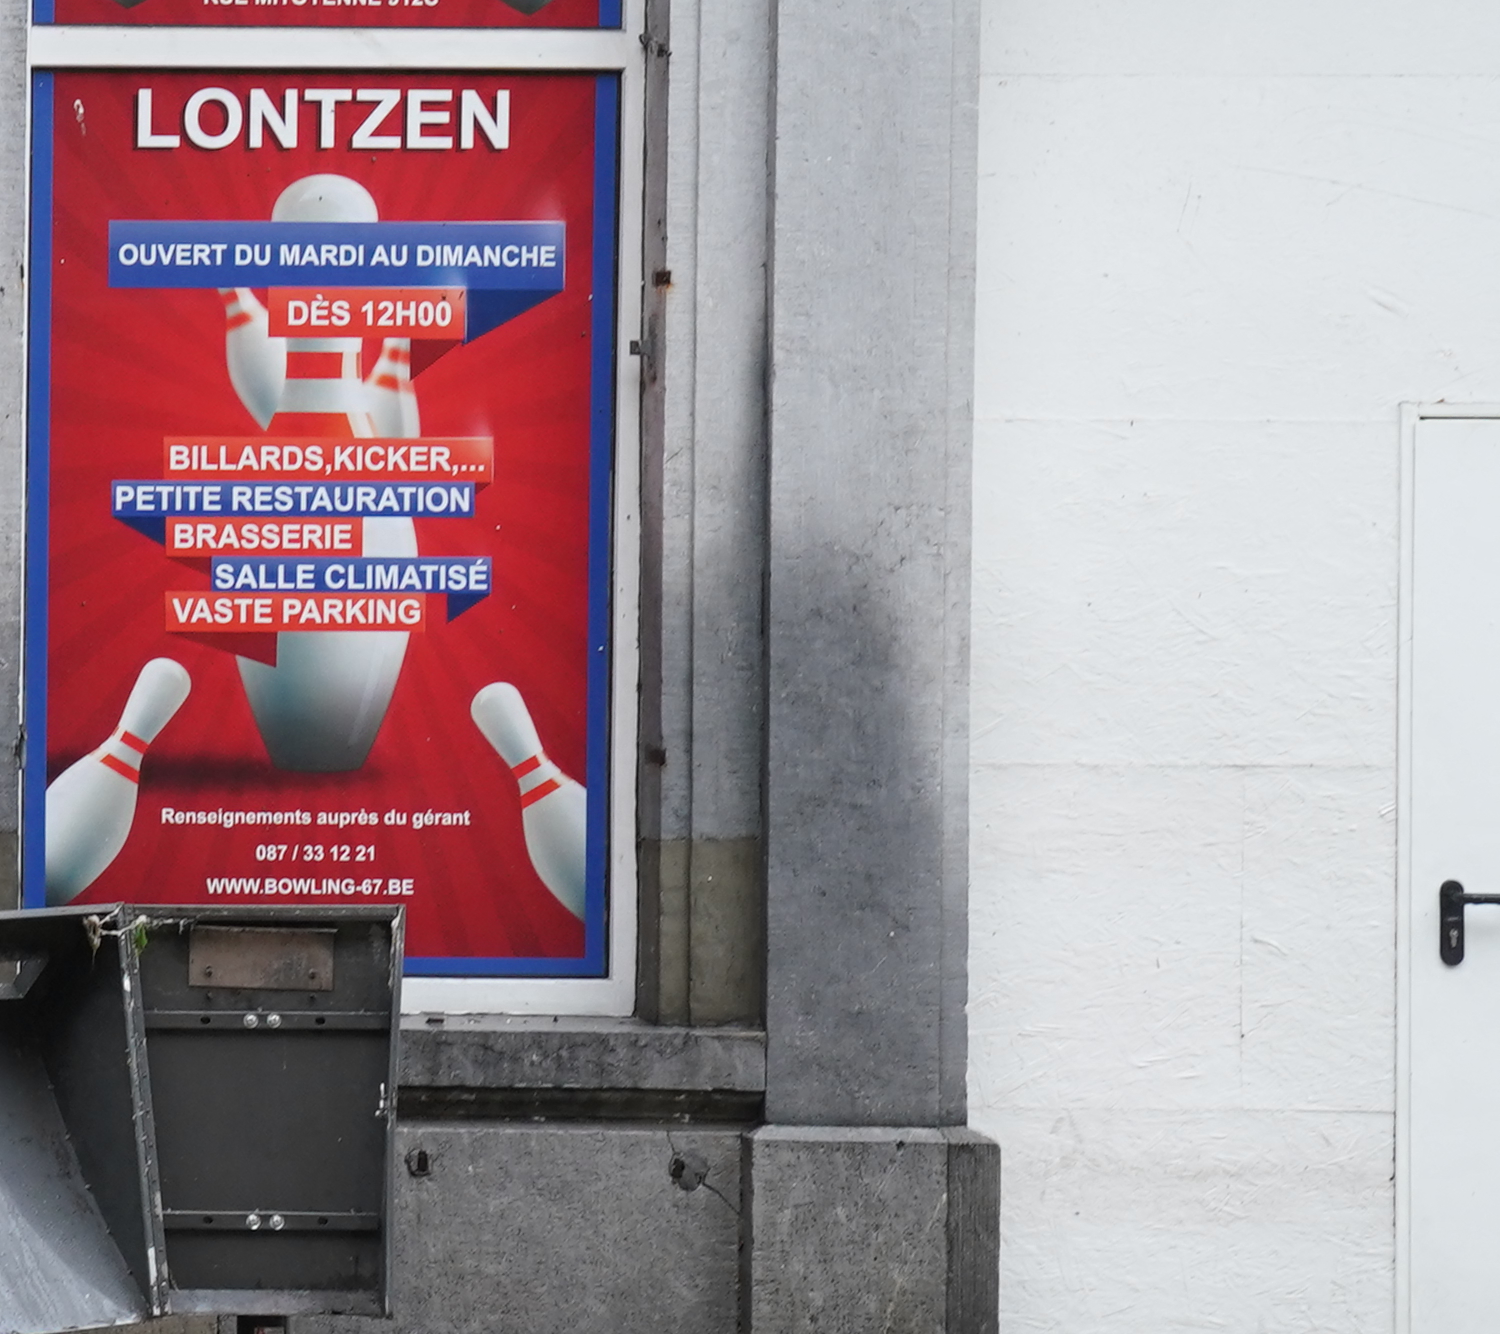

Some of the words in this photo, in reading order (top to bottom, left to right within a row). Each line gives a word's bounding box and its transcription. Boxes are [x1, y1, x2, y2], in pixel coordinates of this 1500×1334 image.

[137, 87, 510, 150] LONTZEN
[118, 243, 228, 266] OUVERT
[235, 243, 271, 266] DU
[279, 244, 365, 267] MARDI
[370, 244, 408, 267] AU
[416, 244, 556, 267] DIMANCHE
[287, 293, 351, 327] DÈS
[361, 300, 452, 327] 12H00
[115, 485, 222, 511] PETITE
[232, 485, 470, 513] RESTAURATION
[174, 523, 352, 550] BRASSERIE
[215, 563, 315, 590] SALLE
[324, 558, 488, 591] CLIMATISÉ
[172, 597, 273, 624] VASTE
[282, 598, 421, 625] PARKING
[161, 807, 312, 829] Renseignements
[316, 808, 379, 829] auprès
[383, 808, 407, 826] du
[412, 808, 471, 830] gérant
[255, 844, 288, 861] 087
[291, 844, 299, 861] /
[303, 844, 325, 862] 33
[329, 844, 351, 862] 12
[355, 844, 375, 862] 21
[206, 877, 414, 895] WWW.BOWLING-67.BE
